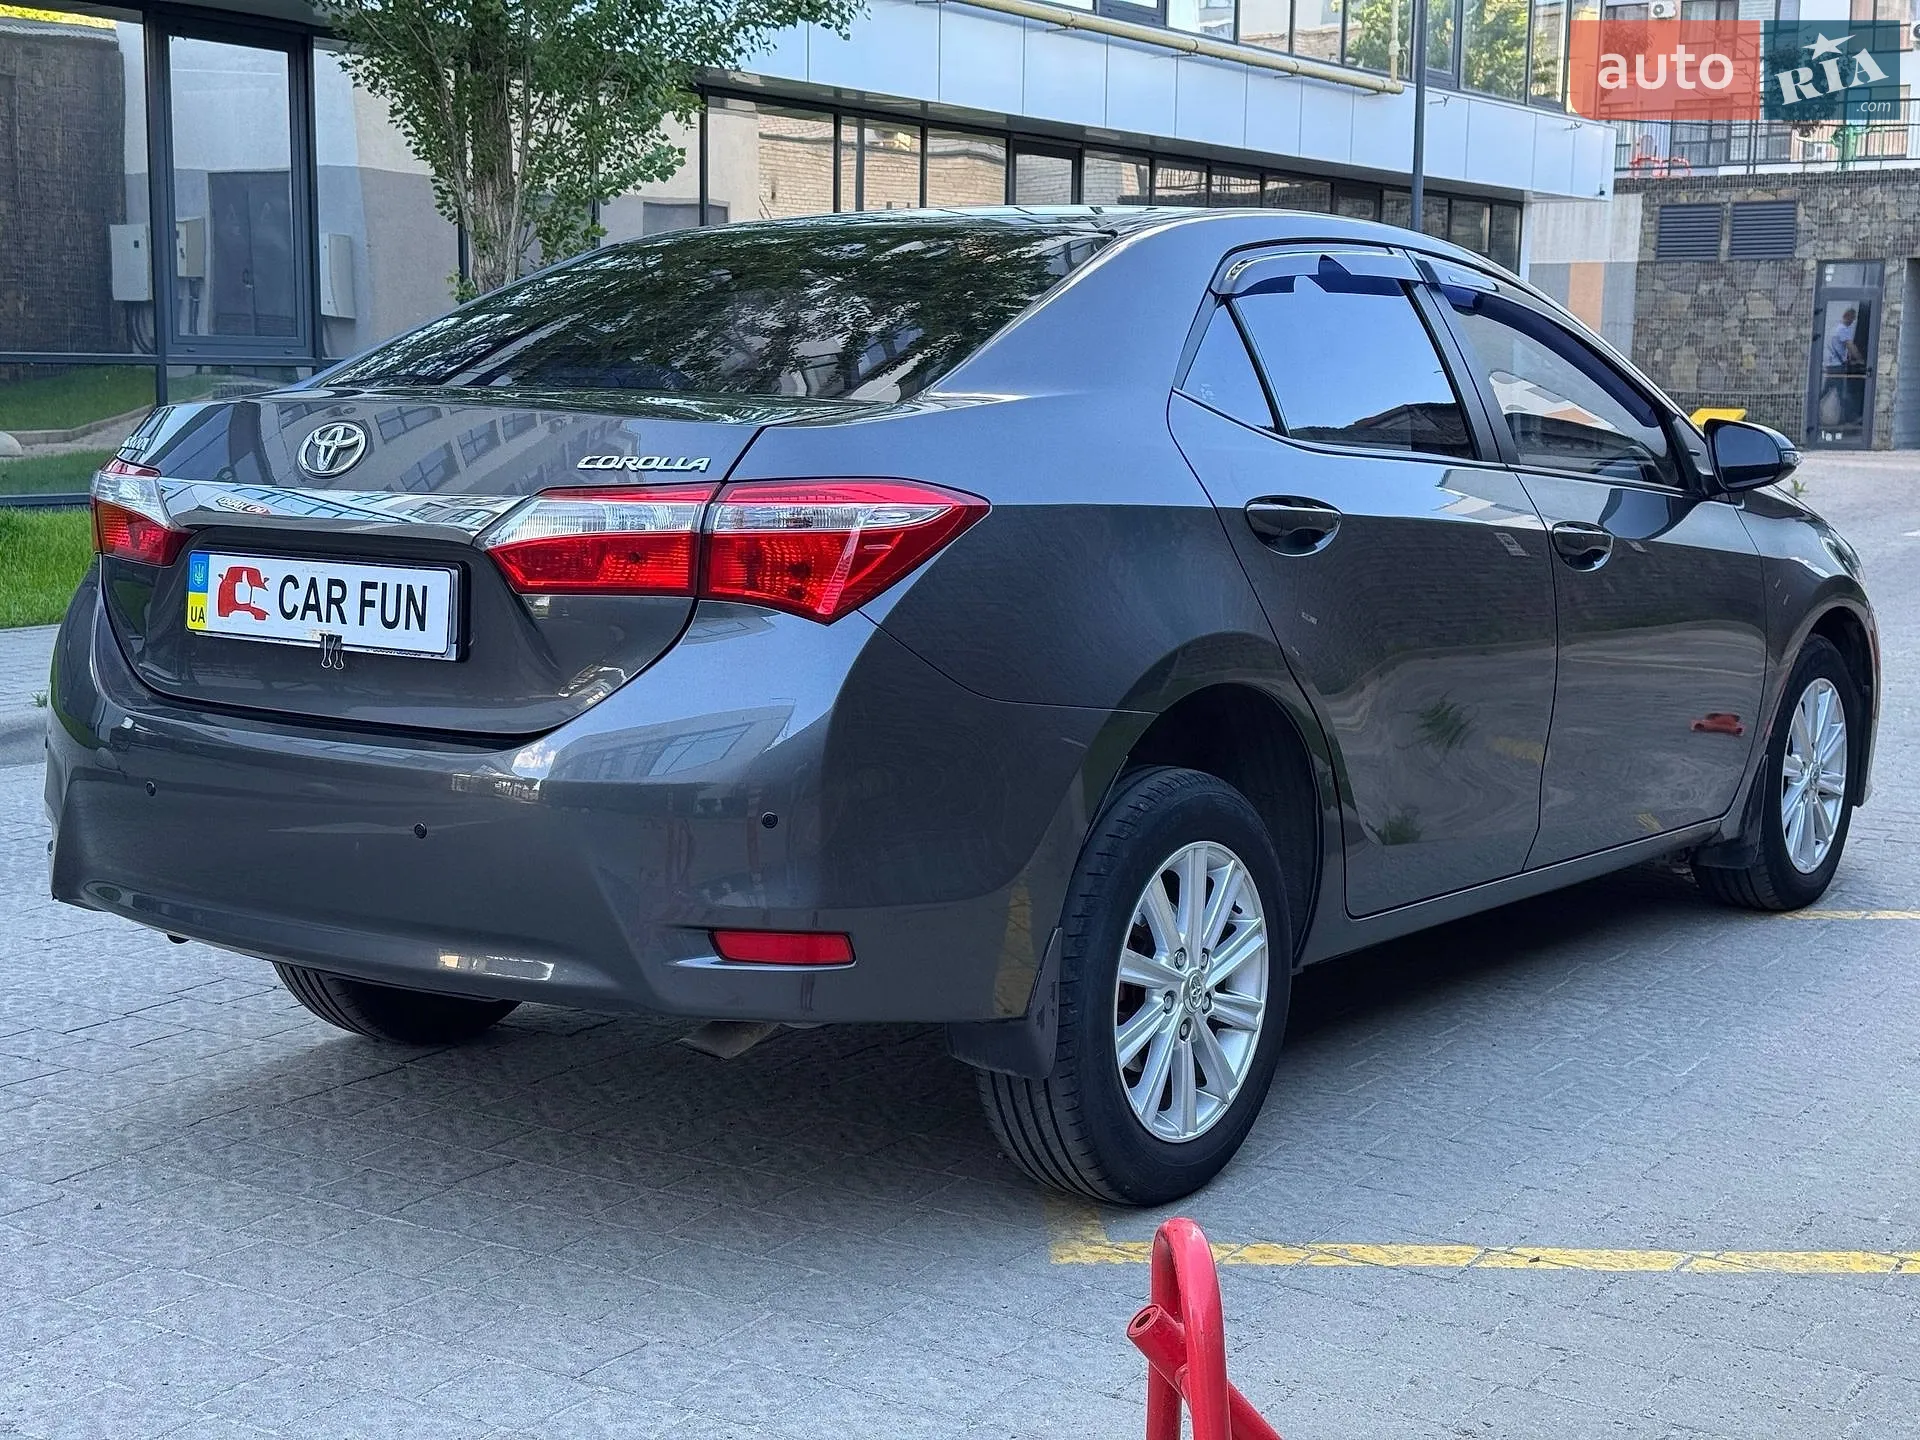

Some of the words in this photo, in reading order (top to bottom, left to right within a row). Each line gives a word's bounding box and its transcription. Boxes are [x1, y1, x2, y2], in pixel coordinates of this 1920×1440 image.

[576, 455, 711, 472] COROLLA
[278, 574, 348, 625] CAR
[358, 580, 428, 632] FUN
[190, 605, 206, 624] UA
